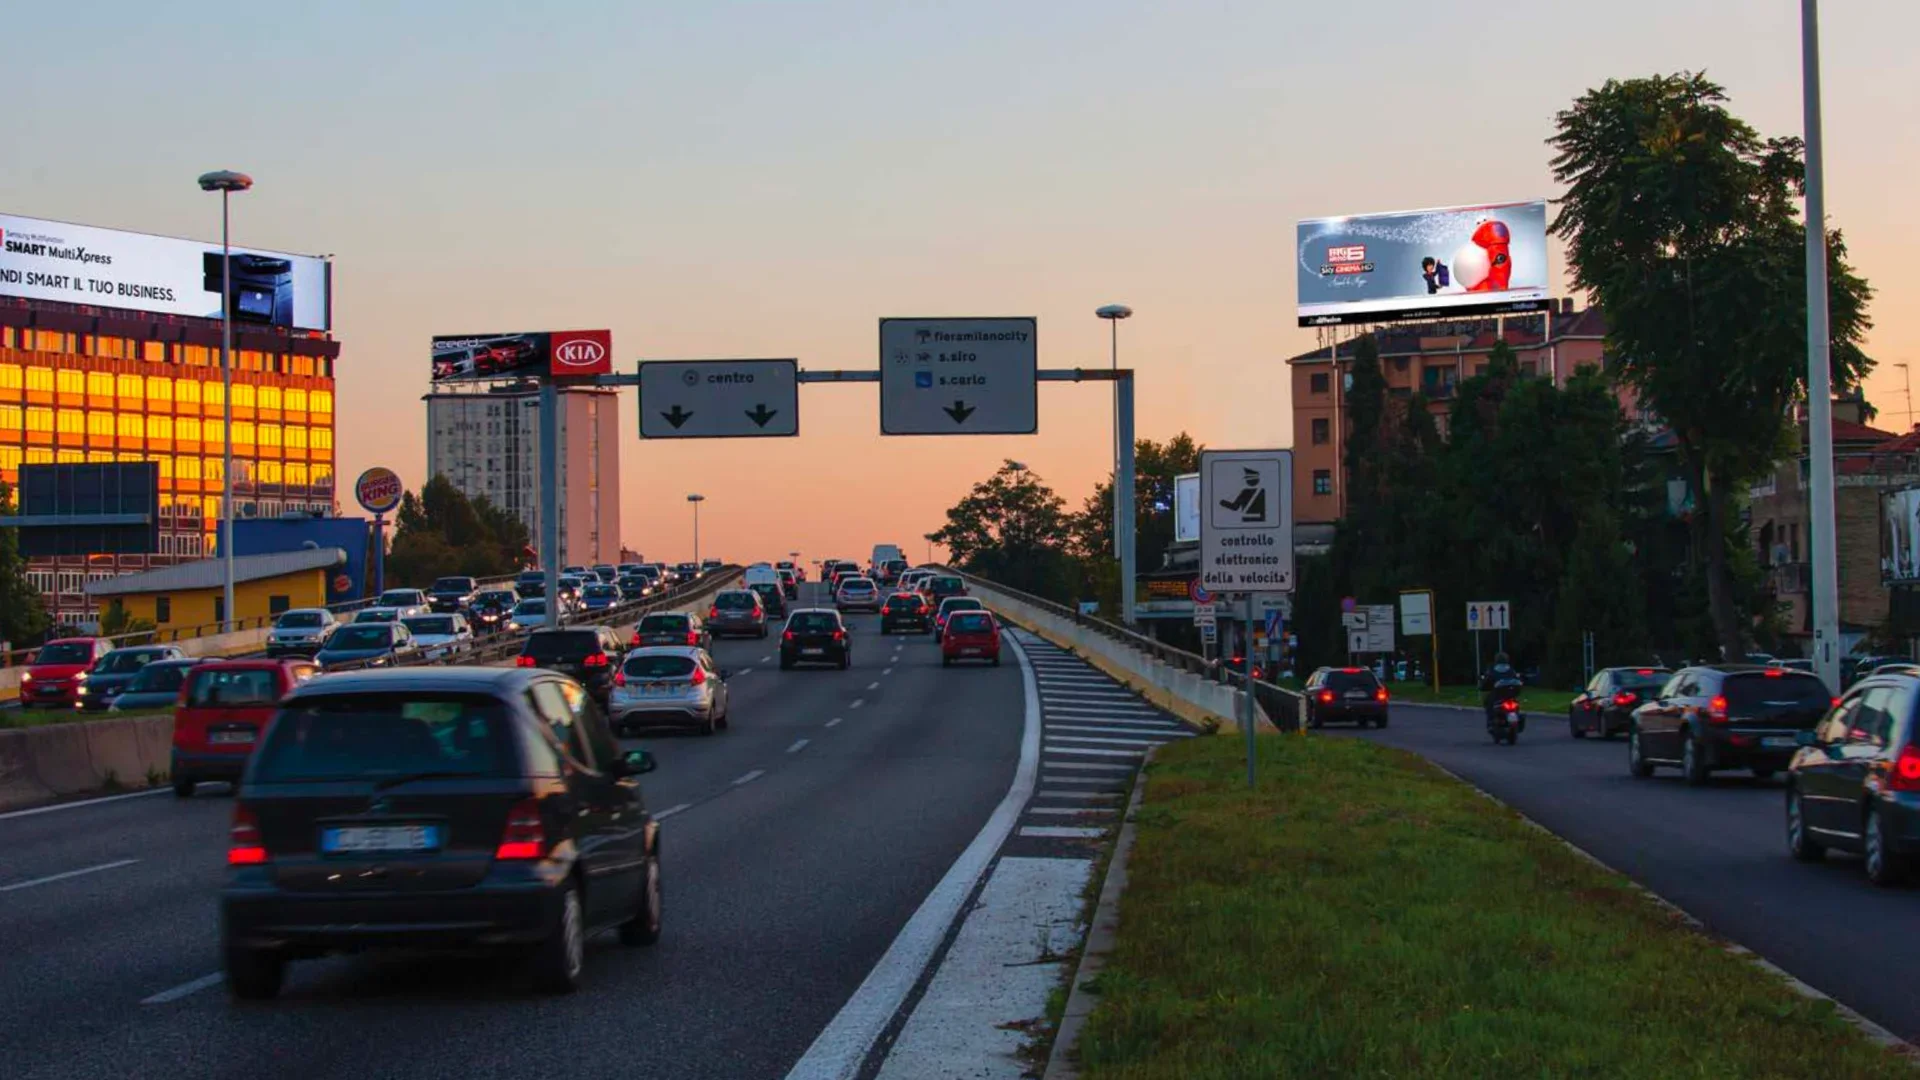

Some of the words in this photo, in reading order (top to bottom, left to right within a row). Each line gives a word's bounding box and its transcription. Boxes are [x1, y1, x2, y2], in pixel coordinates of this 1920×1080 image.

[5, 240, 46, 256] SMART
[48, 246, 112, 264] MultiXpress
[0, 268, 22, 284] NDI
[26, 271, 69, 290] SMART
[74, 276, 83, 291] IL
[88, 279, 114, 296] TUO
[118, 283, 177, 302] BUSINESS.
[934, 331, 1028, 342] fieramilanocity
[564, 344, 598, 361] KIA
[939, 351, 977, 363] s.siro
[707, 371, 755, 384] centro
[939, 375, 987, 386] s.carlo
[362, 482, 399, 503] KING
[1220, 533, 1274, 546] controllo
[1215, 553, 1279, 566] elettronico
[1204, 571, 1233, 584] della
